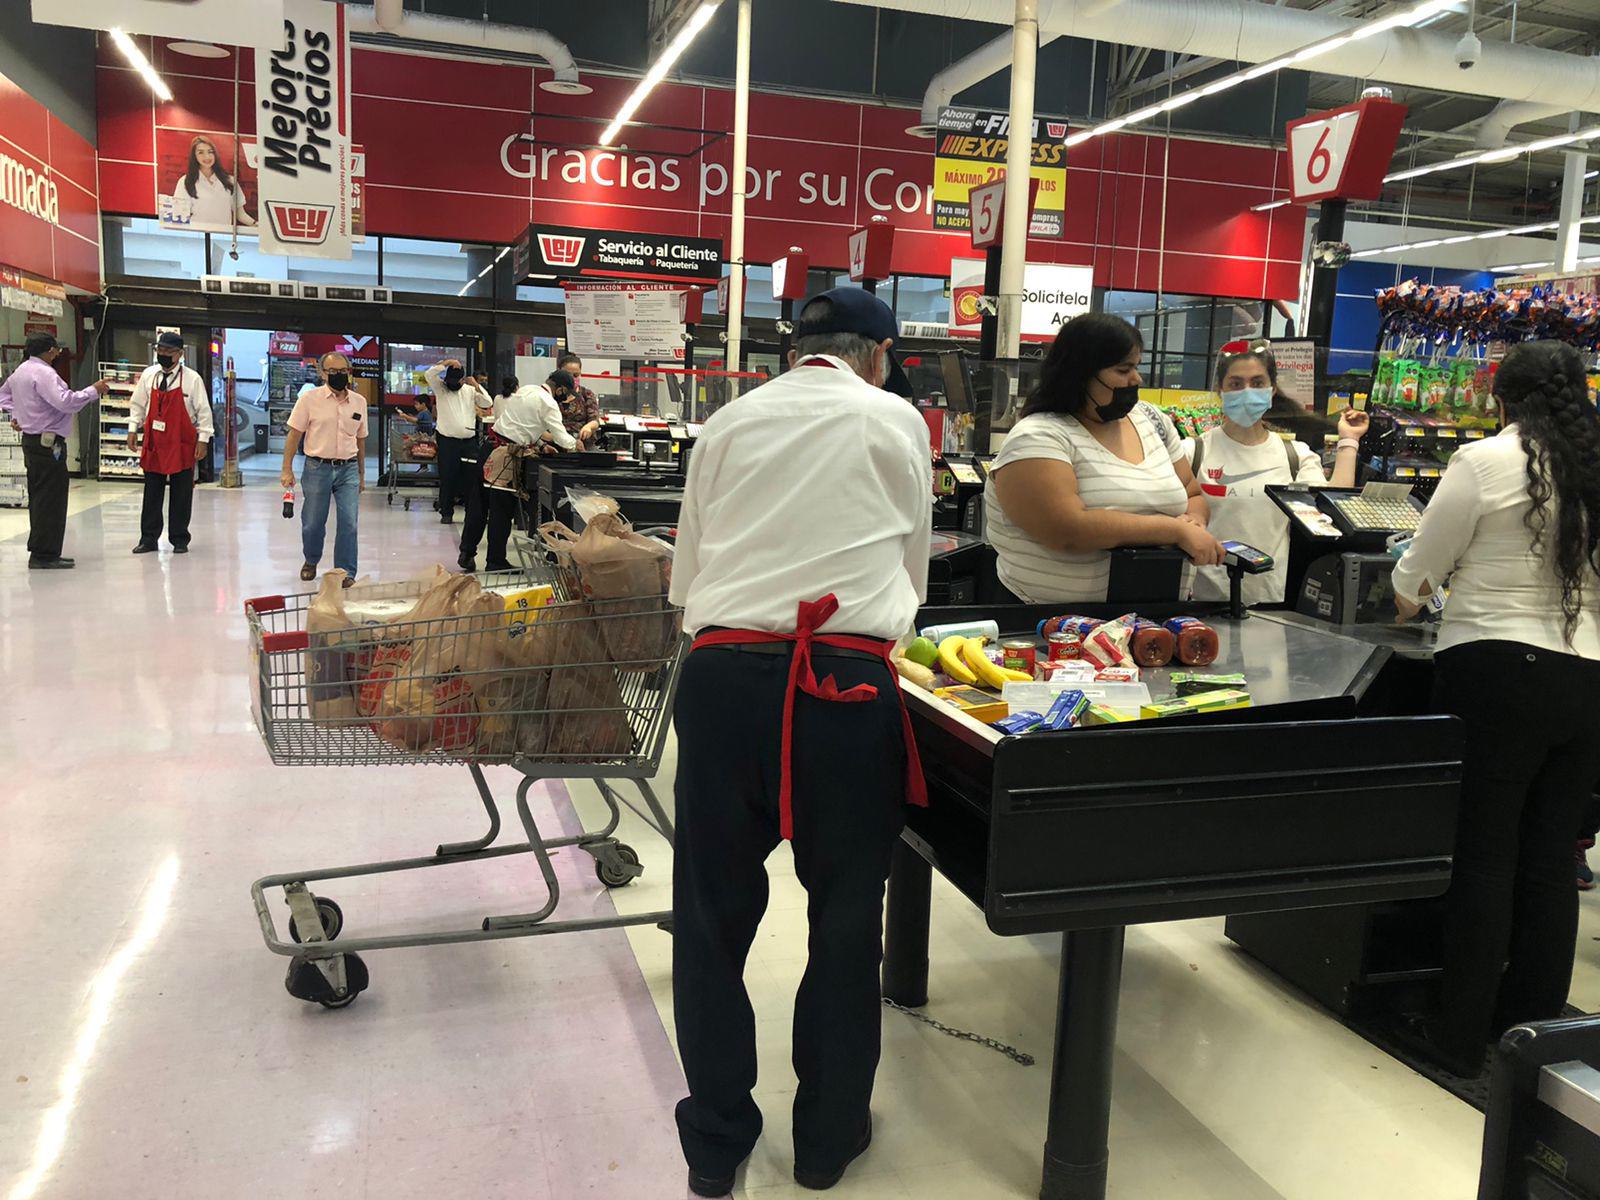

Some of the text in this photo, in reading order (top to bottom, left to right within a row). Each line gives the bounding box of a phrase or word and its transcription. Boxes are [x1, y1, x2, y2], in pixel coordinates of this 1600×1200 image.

[298, 28, 332, 174] Precios
[942, 110, 976, 120] Ahorra
[939, 119, 973, 130] tiempo
[975, 119, 988, 128] en
[1306, 127, 1332, 184] 6
[500, 133, 681, 192] Gracias
[700, 160, 781, 206] por
[798, 172, 848, 207] su
[945, 169, 983, 186] MÁXIMO
[937, 204, 970, 217] Para may
[980, 194, 992, 235] 5
[1032, 213, 1061, 225] ompras,
[937, 216, 947, 226] NO
[598, 239, 718, 262] Servicio al Cliente
[854, 240, 862, 270] 4
[599, 255, 699, 272] Tabaquería Paquetería
[1021, 289, 1089, 306] Solicítela
[515, 599, 528, 609] 18
